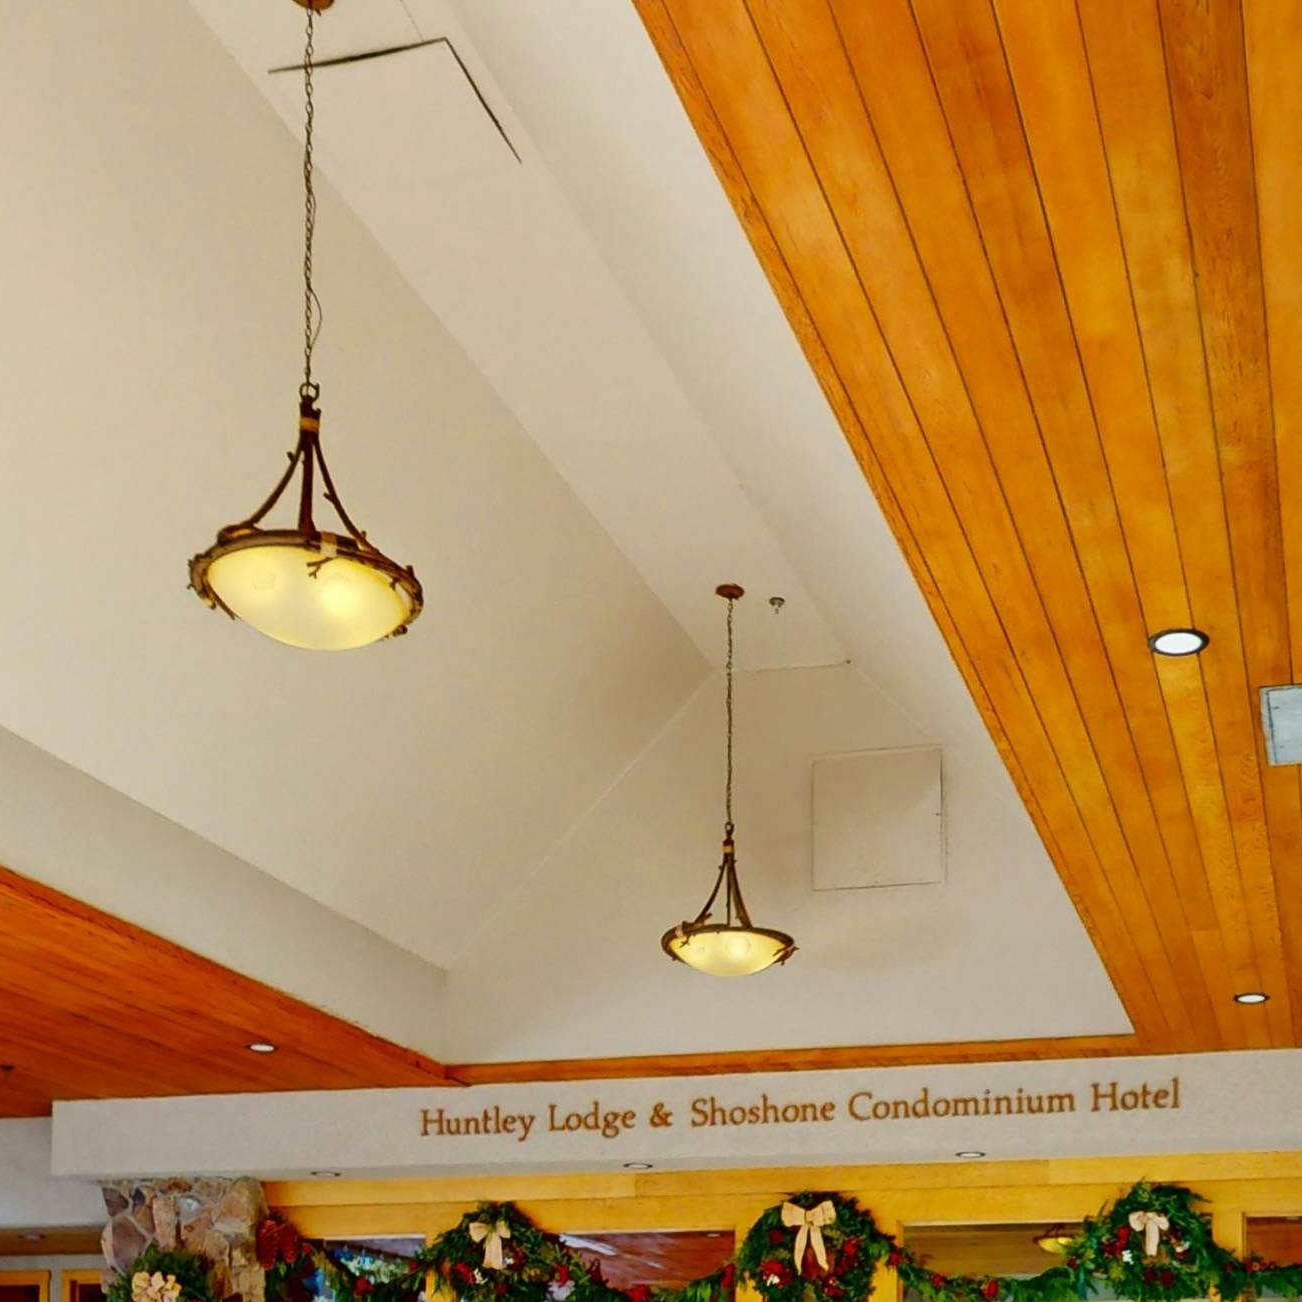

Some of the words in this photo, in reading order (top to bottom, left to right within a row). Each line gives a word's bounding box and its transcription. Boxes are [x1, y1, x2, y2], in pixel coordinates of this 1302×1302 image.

[420, 1106, 535, 1142] Huntley
[548, 1101, 636, 1138] Lodge
[649, 1101, 673, 1128] &
[690, 1093, 836, 1128] Shoshone
[847, 1087, 1076, 1122] Condominium
[1090, 1076, 1180, 1112] Hotel
